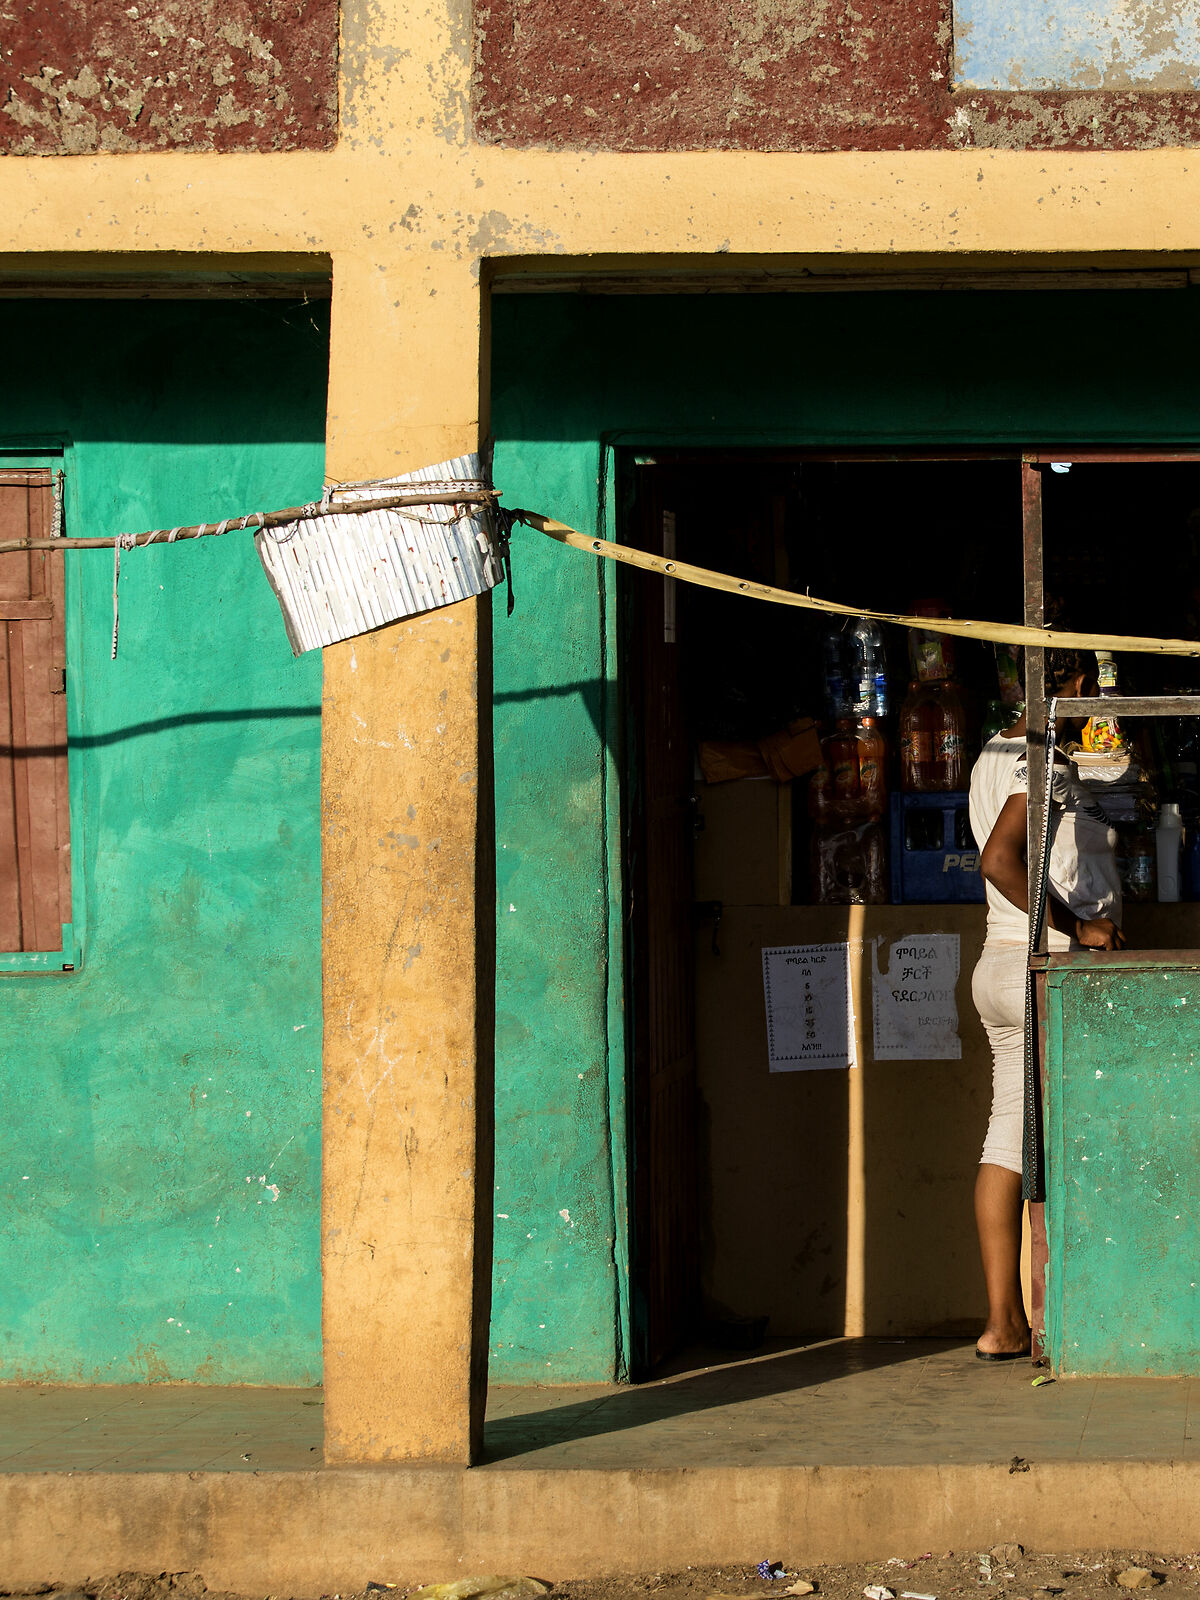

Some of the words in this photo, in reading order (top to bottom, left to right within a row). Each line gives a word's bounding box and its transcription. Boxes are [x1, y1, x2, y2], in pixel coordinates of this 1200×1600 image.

[895, 947, 938, 960] ሞባይል
[785, 956, 809, 965] ሞባይል
[810, 955, 827, 964] ካርድ
